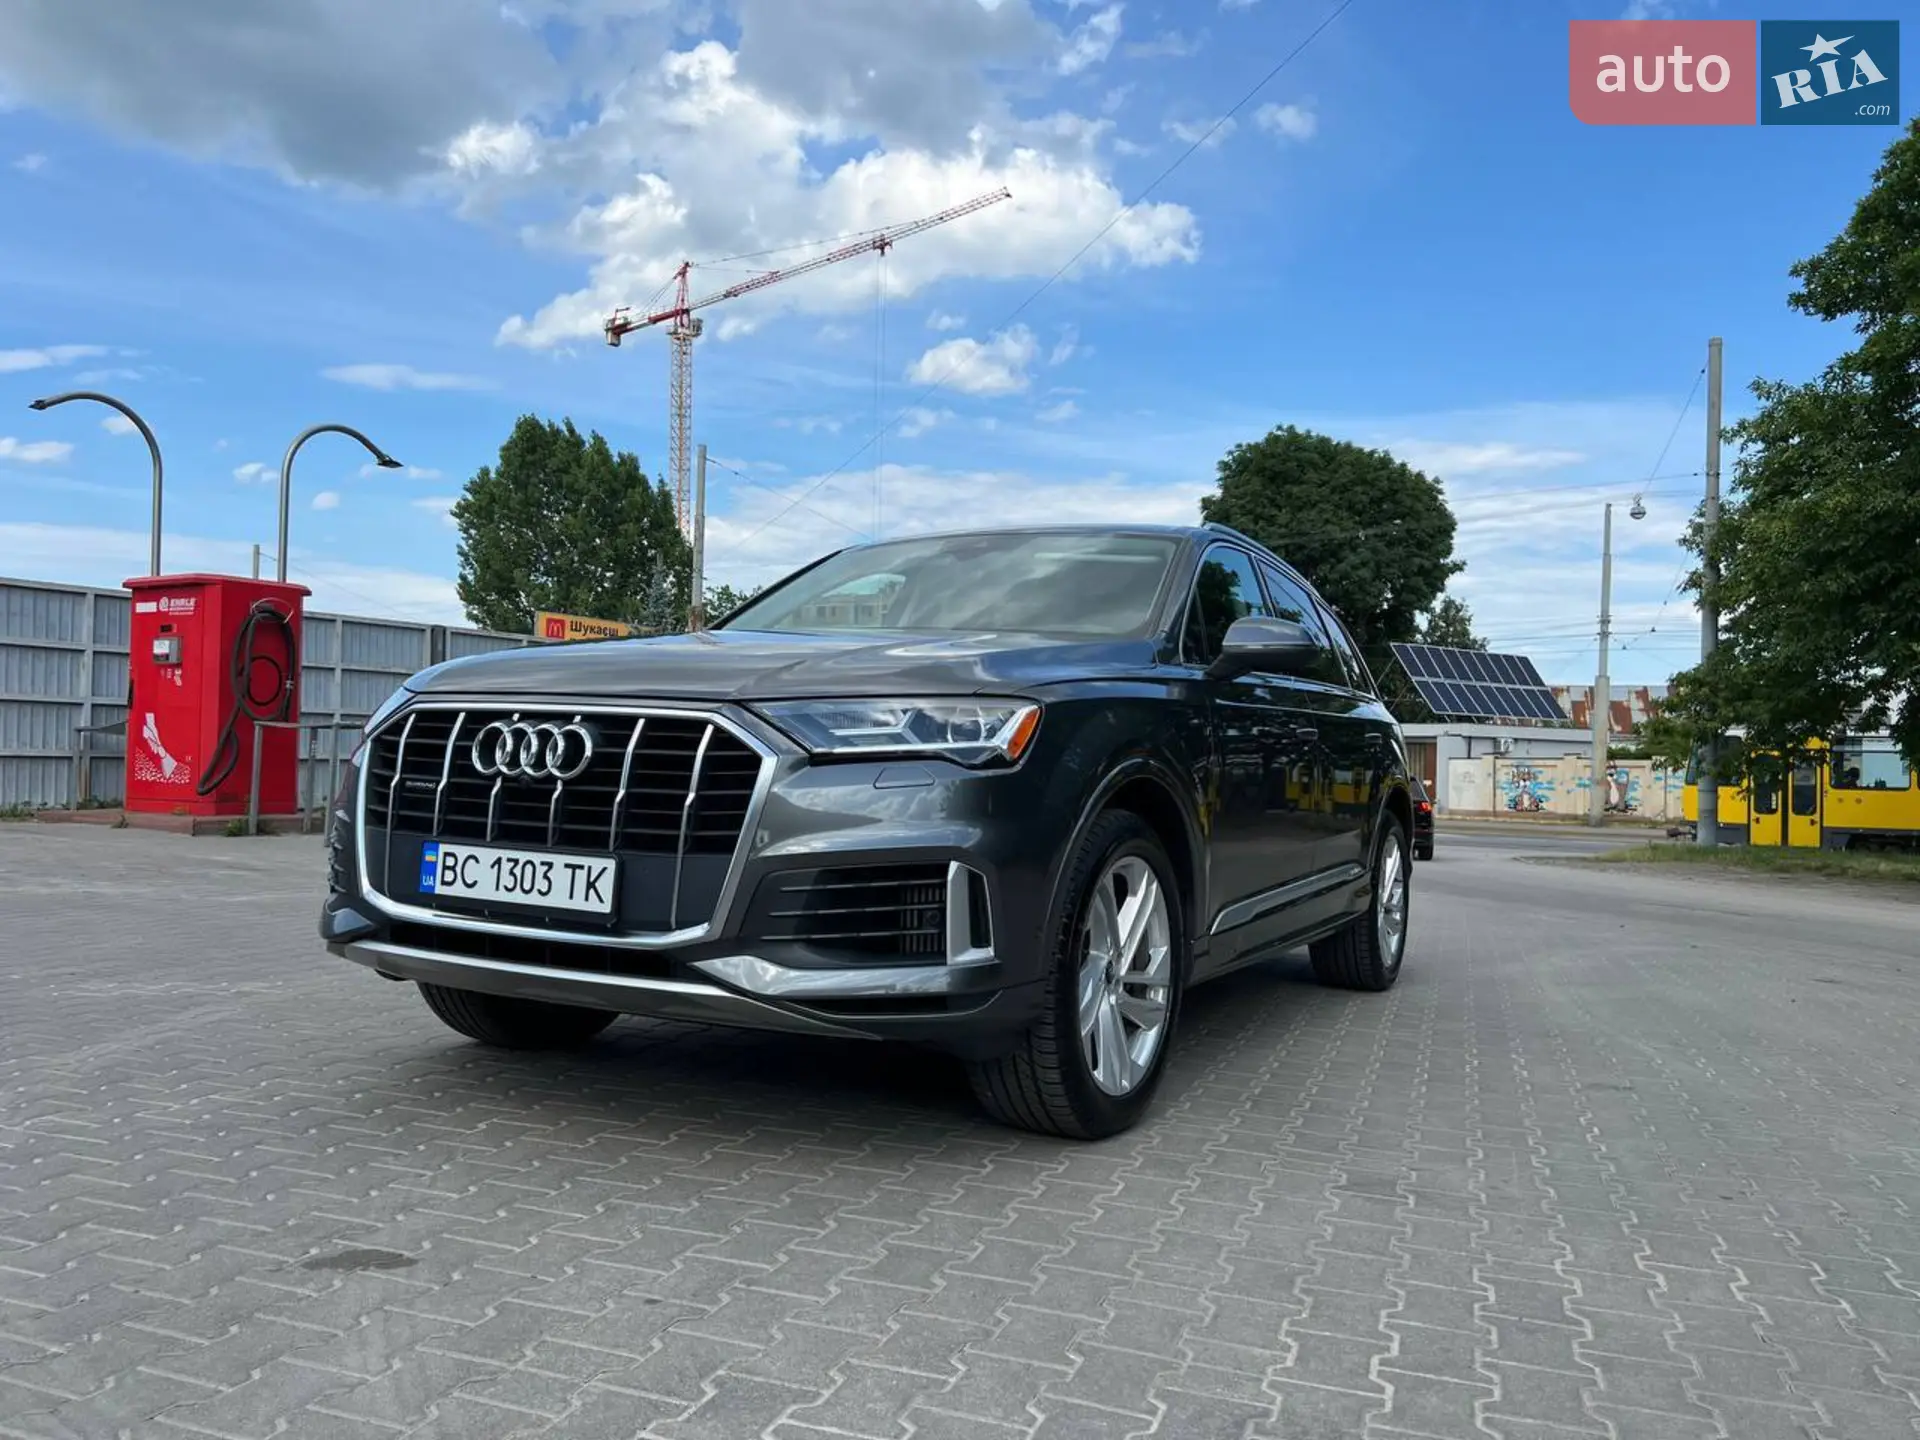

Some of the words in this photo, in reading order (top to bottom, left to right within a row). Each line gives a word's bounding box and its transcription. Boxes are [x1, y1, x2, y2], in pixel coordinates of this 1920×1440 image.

[422, 875, 434, 887] UA
[441, 851, 480, 889] BC
[490, 856, 554, 897] 1303
[563, 863, 608, 904] TK
